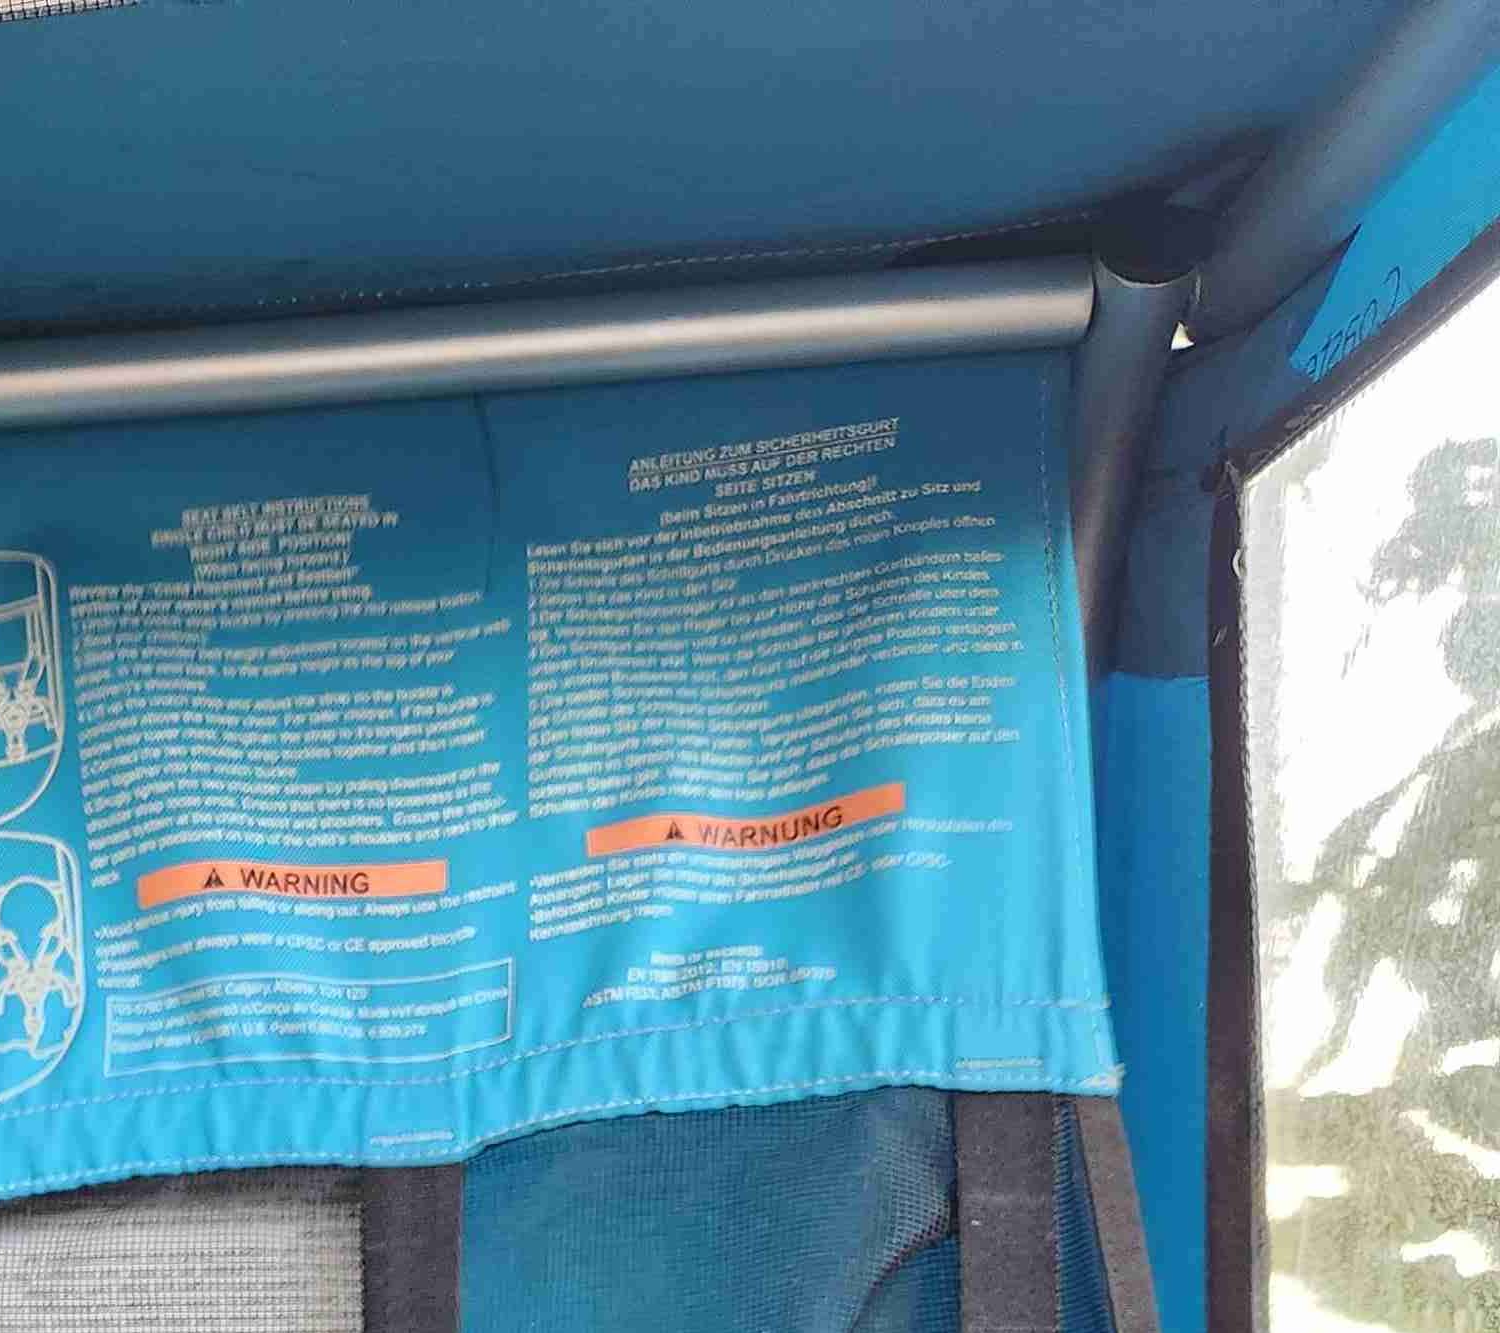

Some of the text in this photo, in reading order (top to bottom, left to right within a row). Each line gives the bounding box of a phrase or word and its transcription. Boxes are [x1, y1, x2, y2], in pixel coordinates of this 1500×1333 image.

[629, 416, 900, 474] ANLEITUNG ZUM SICHERHEITSGURT
[629, 434, 897, 494] DAS KIND MUSS AUF DER RECHTEN
[714, 468, 817, 498] SEITE SITZEN
[921, 482, 950, 496] Sitz
[953, 480, 983, 494] und
[697, 804, 845, 846] WARNUNG
[241, 868, 370, 895] WARNING
